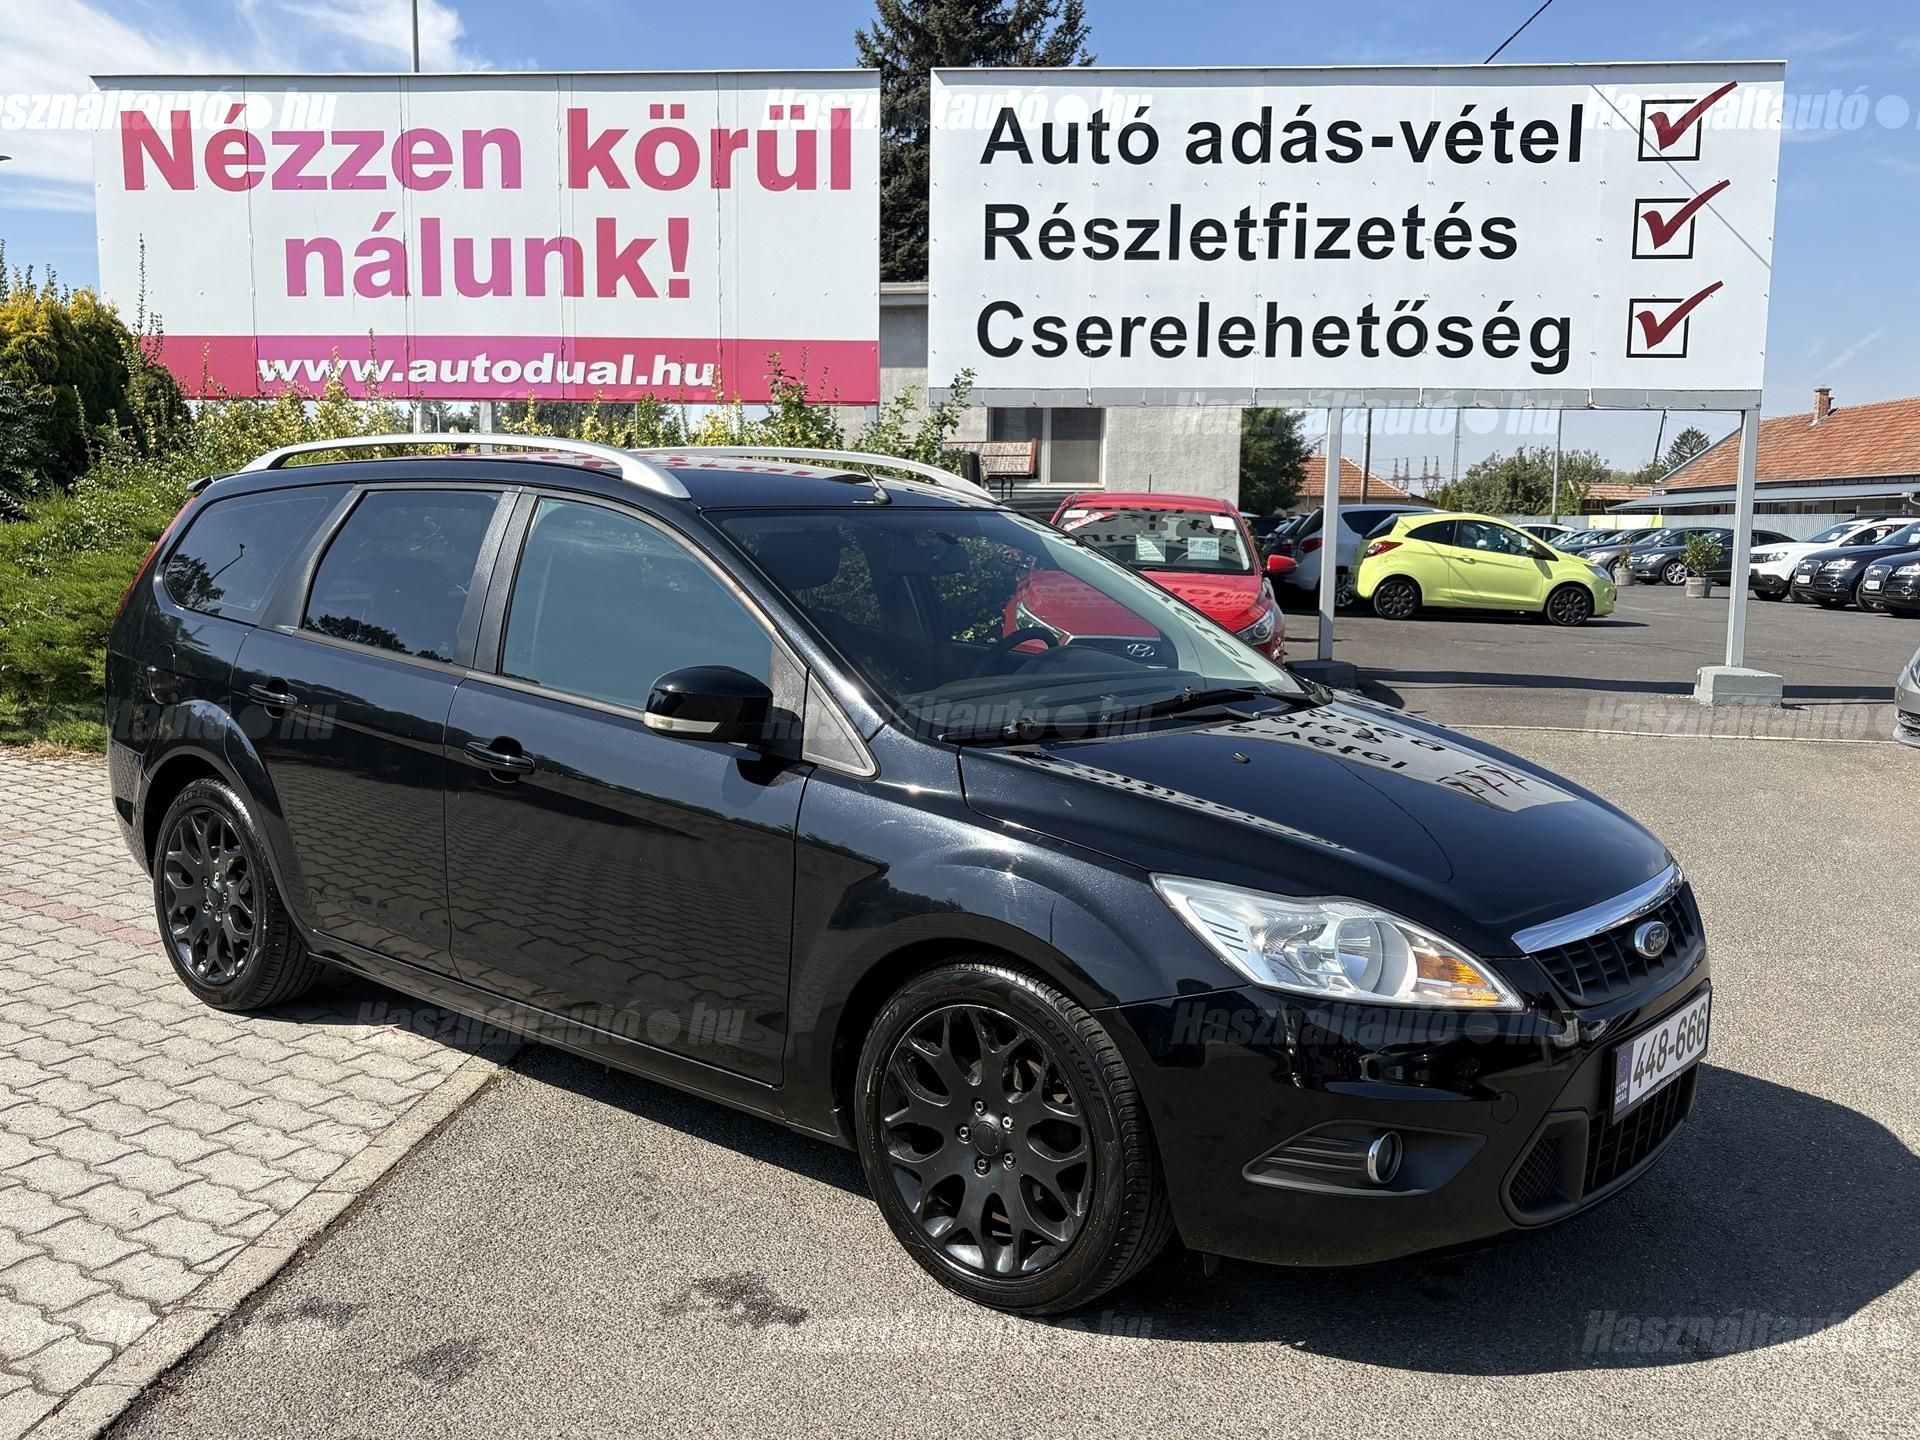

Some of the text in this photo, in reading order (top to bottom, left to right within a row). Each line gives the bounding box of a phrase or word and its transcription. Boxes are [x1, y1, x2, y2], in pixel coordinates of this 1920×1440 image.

[120, 104, 852, 191] Nézzen körül
[980, 103, 1583, 166] Autó adás-vétel
[286, 212, 690, 298] nálunk!
[984, 201, 1518, 262] Részletfizetés
[257, 351, 714, 388] www.autodual.hu
[976, 299, 1571, 376] Cserelehetőség
[1632, 1001, 1707, 1089] 448-666
